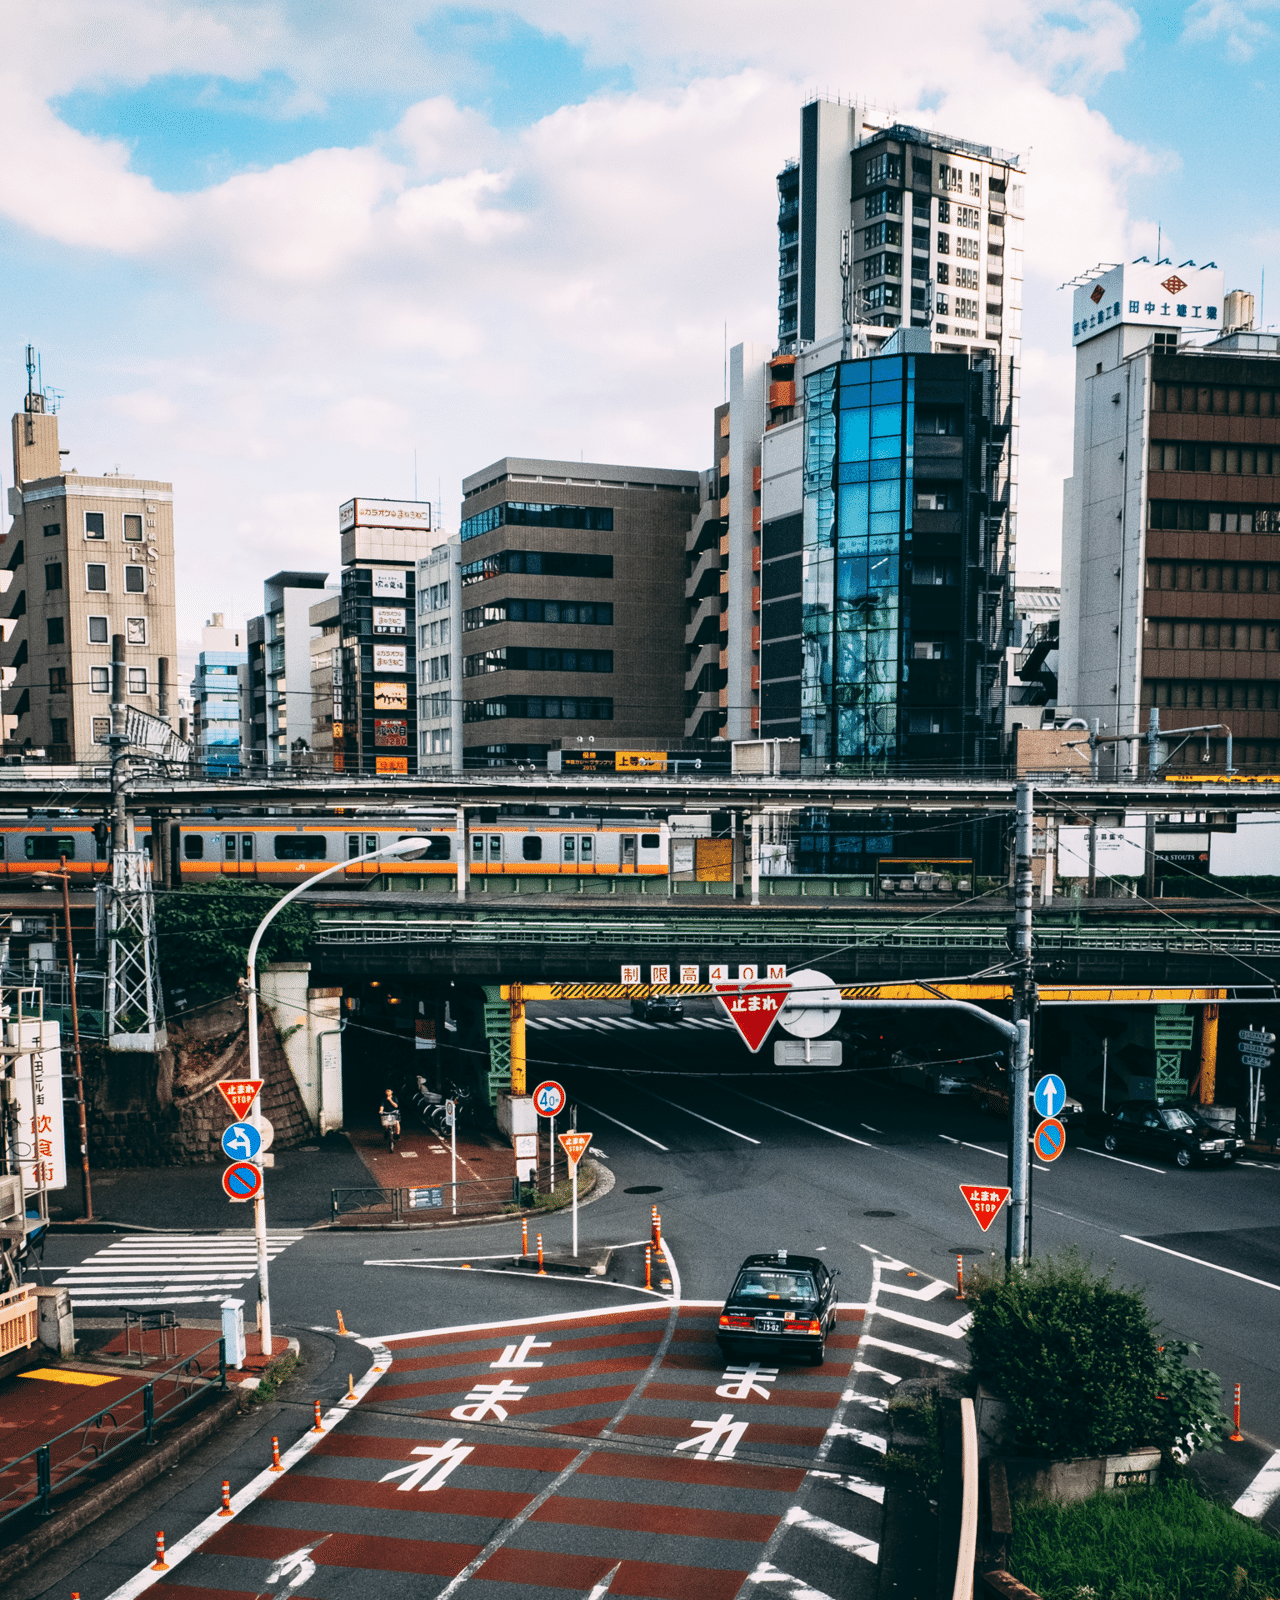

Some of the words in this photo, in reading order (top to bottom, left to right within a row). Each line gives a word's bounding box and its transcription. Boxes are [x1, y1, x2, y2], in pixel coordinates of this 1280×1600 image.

[730, 995, 779, 1012] 止まれ
[226, 1085, 255, 1095] 止まれ
[231, 1096, 252, 1105] STOP
[565, 1137, 586, 1145] 止まれ
[970, 1190, 1000, 1202] 止まれ
[975, 1203, 996, 1212] STOP
